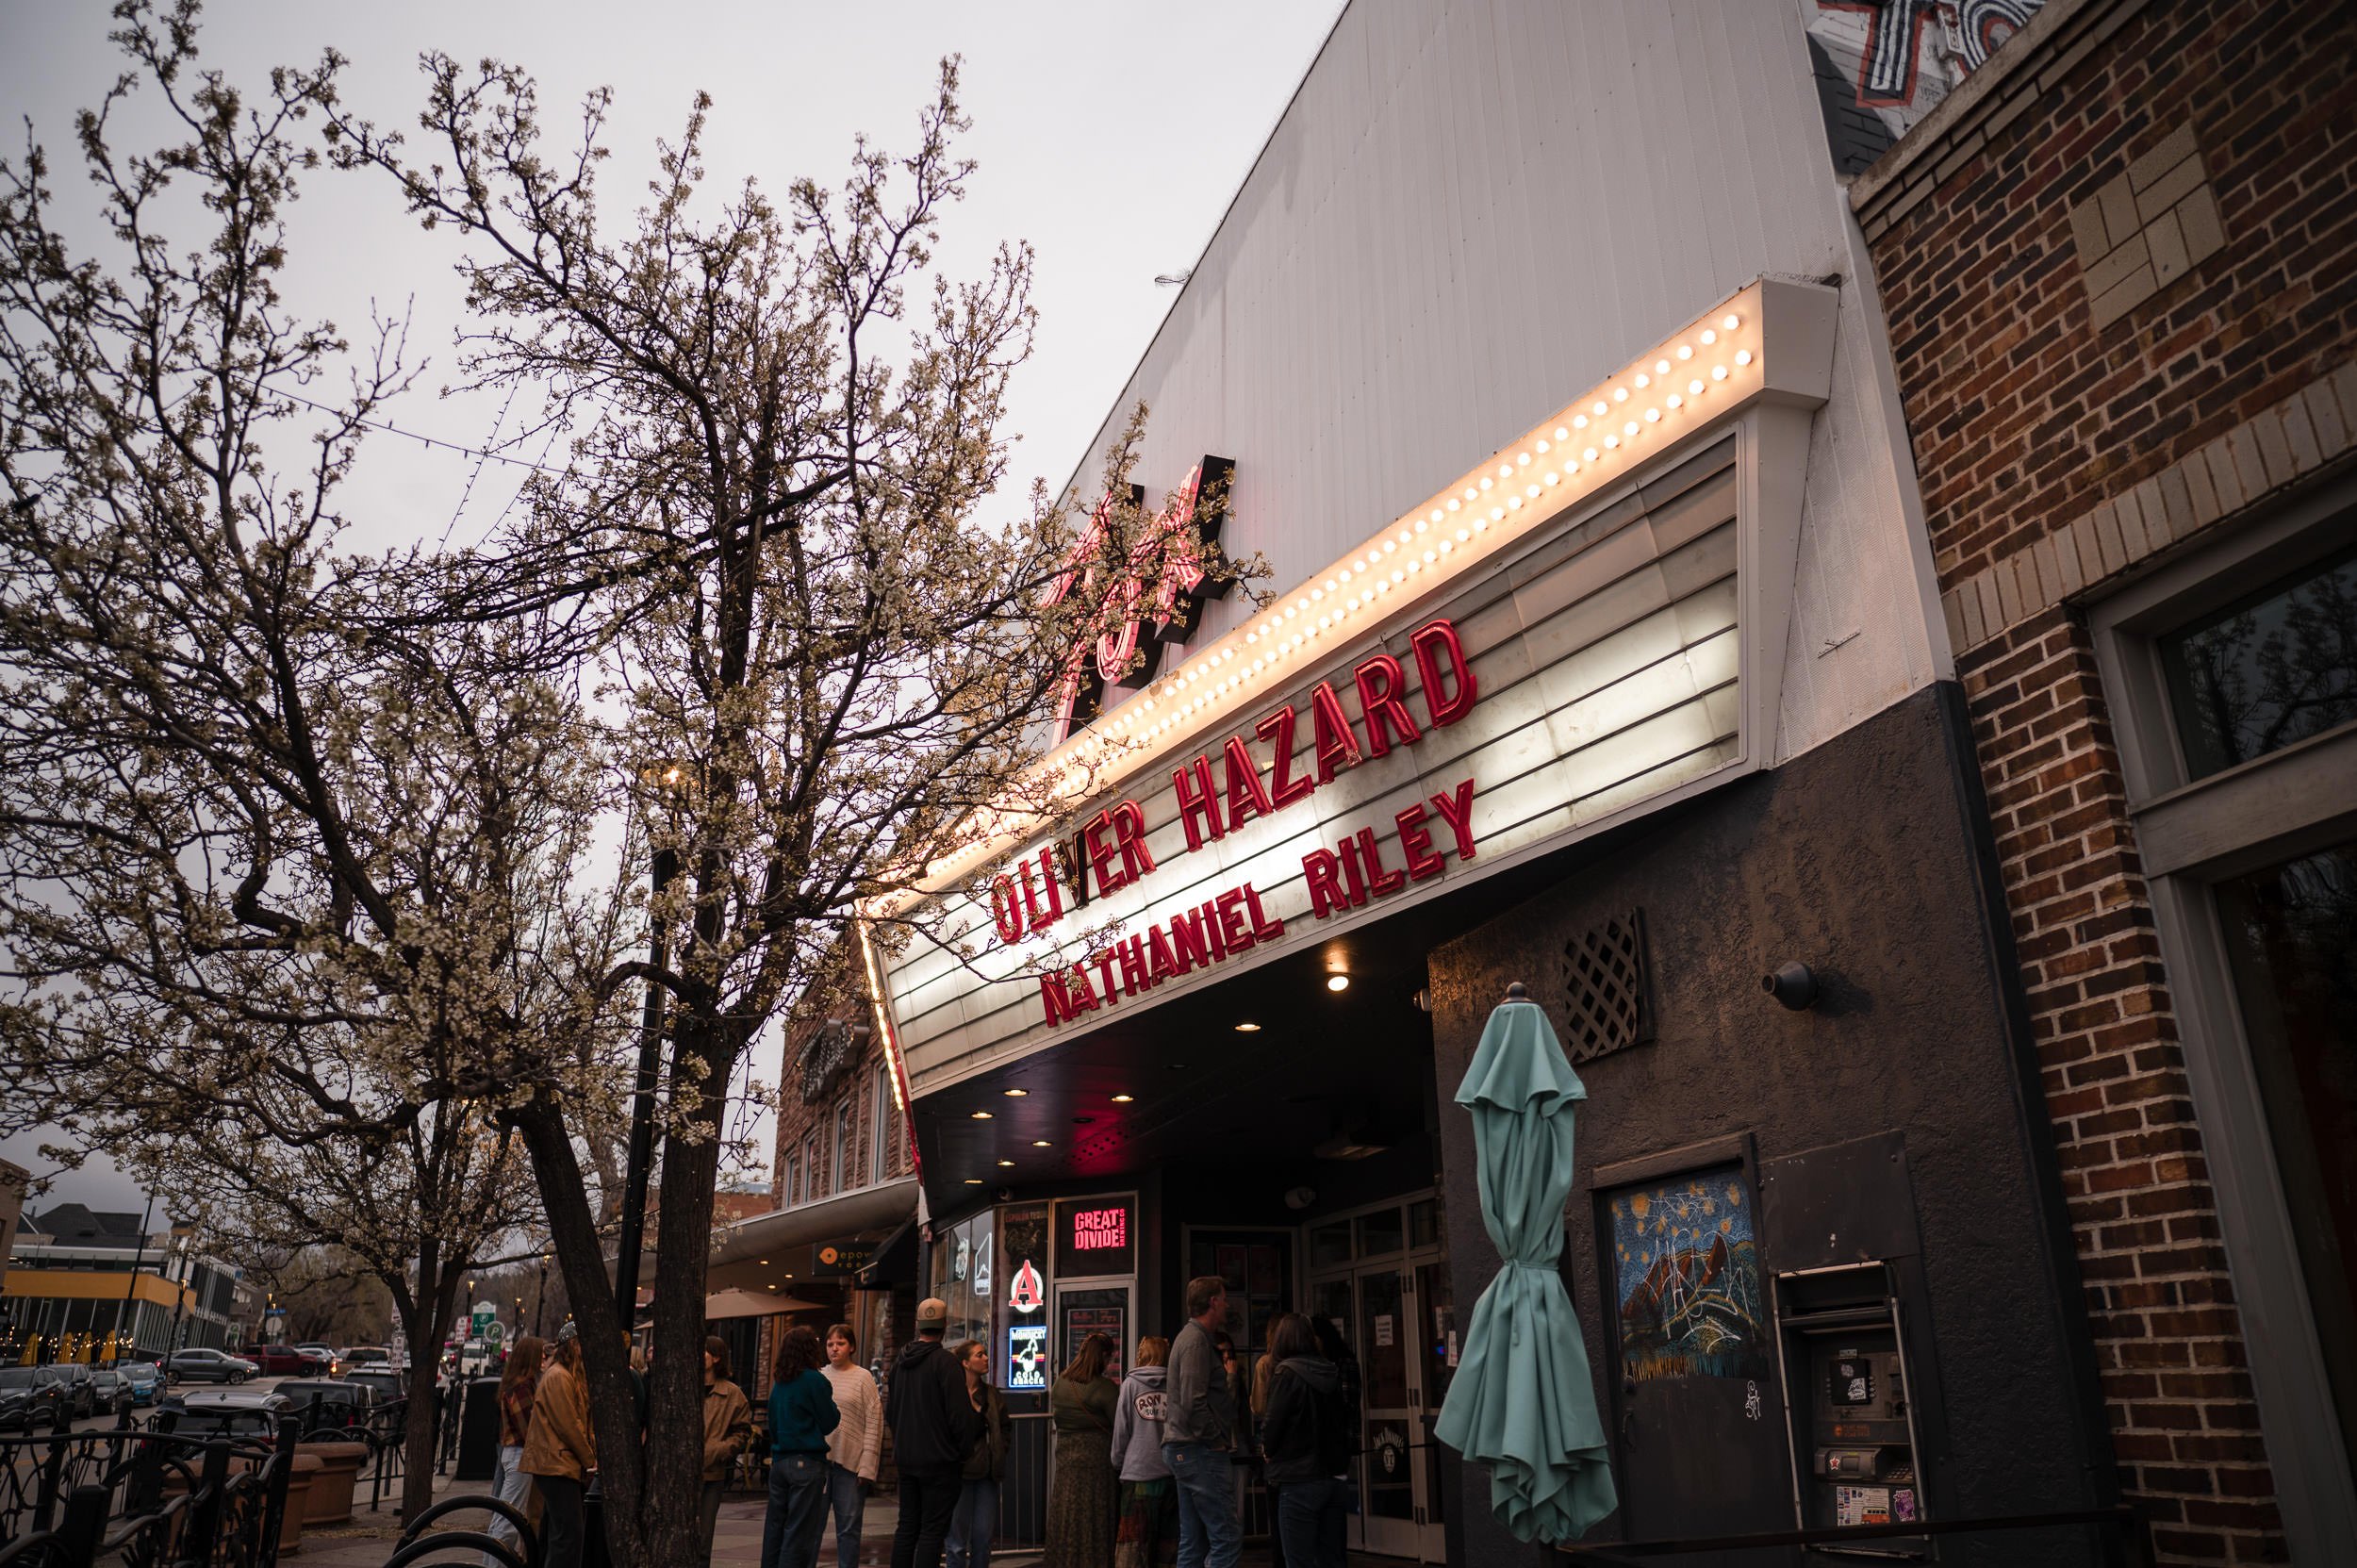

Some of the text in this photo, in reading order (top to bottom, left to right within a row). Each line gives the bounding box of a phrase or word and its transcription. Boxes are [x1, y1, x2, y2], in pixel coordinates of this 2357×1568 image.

[991, 618, 1478, 946] OLIVER HAZARD
[1040, 777, 1477, 1029] NATHANIEL RILEY
[1074, 1208, 1119, 1231] GREAT
[1074, 1228, 1120, 1250] DIVIDE
[1009, 1259, 1044, 1307] A
[1139, 1395, 1161, 1411] RON
